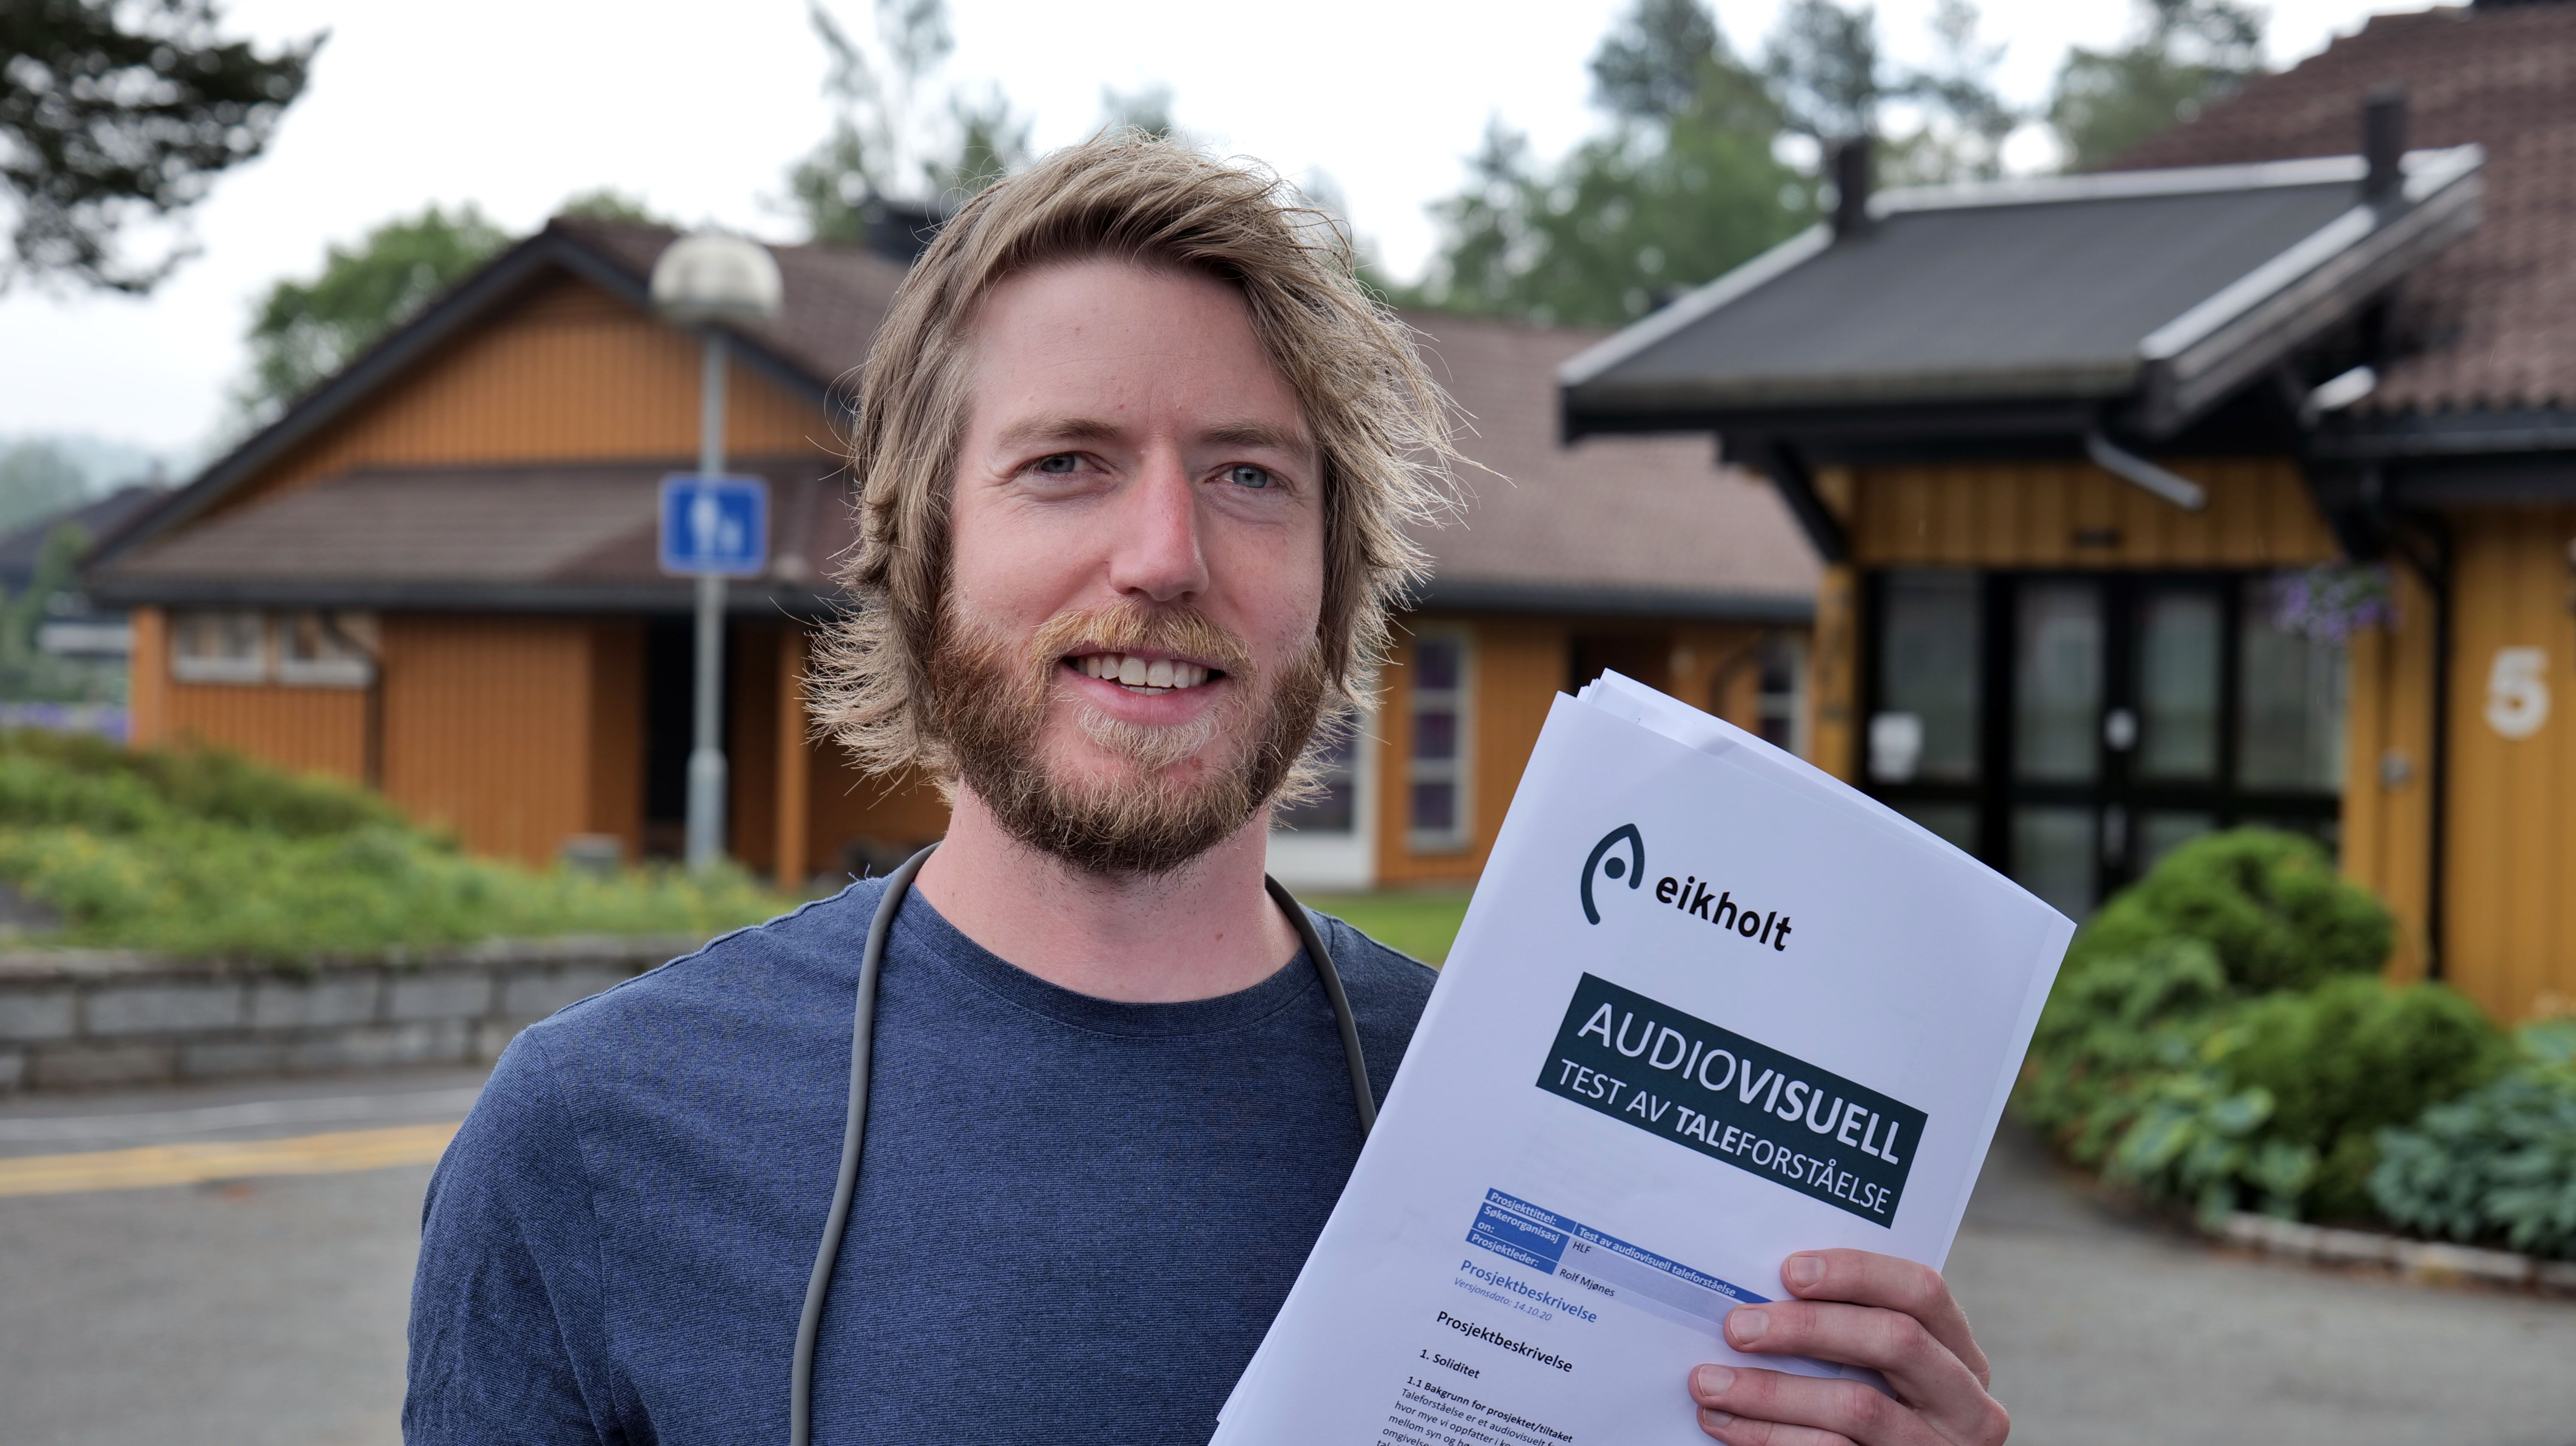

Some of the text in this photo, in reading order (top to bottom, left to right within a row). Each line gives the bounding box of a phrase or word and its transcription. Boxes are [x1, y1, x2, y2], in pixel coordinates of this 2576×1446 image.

[2482, 645, 2552, 741] 5
[1655, 876, 1792, 951] eikholt
[1577, 1003, 1899, 1164] AUDIOVISUELL
[1558, 1058, 1892, 1214] TEST AV TALEFORSTÅELSE
[1478, 1222, 1495, 1233] on:
[1484, 1206, 1560, 1244] Søkerorganisasj
[1490, 1192, 1557, 1225] Prosjekttittel:
[1471, 1233, 1539, 1267] Prosjektleder:
[1572, 1241, 1592, 1254] HLF
[1580, 1227, 1736, 1297] Test av audiovisuell taleforståelse
[1454, 1277, 1552, 1321] Versjonsdato: 14.10.20
[1461, 1260, 1597, 1323] Prosjektbeskrivelse
[1559, 1268, 1615, 1297] Rolf Mjønes
[1419, 1349, 1480, 1379] 1. Soliditet
[1437, 1311, 1572, 1372] Prosjektbeskrivelse
[1388, 1416, 1424, 1433] mellom
[1425, 1429, 1442, 1440] syn
[1444, 1436, 1456, 1446] og
[1394, 1401, 1416, 1415] hvor
[1418, 1411, 1437, 1423] mye
[1450, 1423, 1494, 1443] oppfatter
[1494, 1437, 1499, 1446] i
[1402, 1388, 1464, 1418] Taleforståelse
[1466, 1414, 1476, 1422] er
[1478, 1419, 1488, 1427] et
[1489, 1423, 1546, 1446] audiovisuelt
[1407, 1376, 1422, 1388] 1.1
[1424, 1382, 1469, 1405] Bakgrunn
[1472, 1400, 1486, 1411] for
[1486, 1408, 1573, 1443] prosjektet/tiltaket
